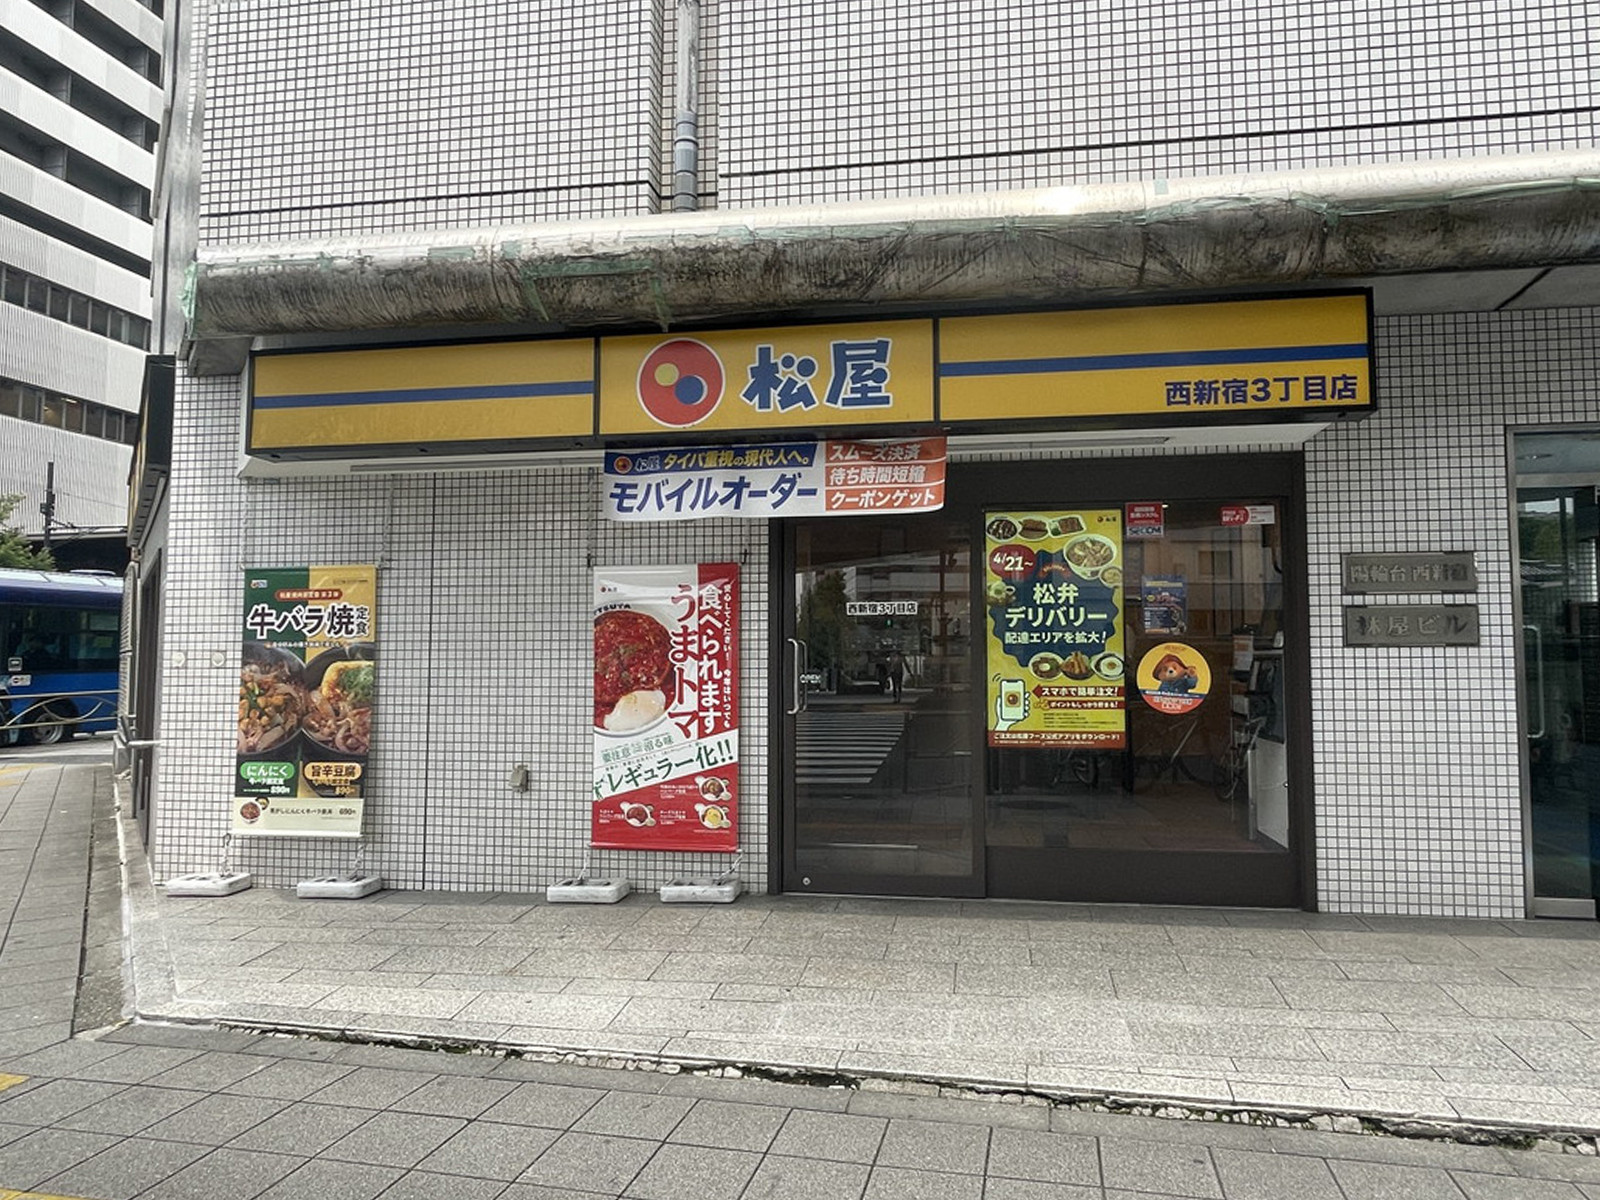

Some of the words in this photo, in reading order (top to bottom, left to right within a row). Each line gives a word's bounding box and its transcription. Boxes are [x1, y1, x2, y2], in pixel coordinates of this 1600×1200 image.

[740, 338, 893, 413] 松屋
[1164, 374, 1359, 407] 西新宿3丁目店
[664, 448, 810, 470] タイパ重視の現代人へ。
[829, 444, 922, 461] スムーズ決済
[830, 465, 926, 485] 待ち時間短縮
[609, 472, 819, 514] モバイルオーダー
[831, 488, 936, 509] クーポンゲット
[1033, 582, 1080, 605] 松弁
[848, 602, 917, 614] 西新宿3丁目店
[1005, 606, 1108, 628] デリバリー
[246, 603, 355, 639] 牛バラ焼
[1004, 631, 1106, 644] 配達エリアを拡大!
[667, 583, 699, 739] うまトマ
[699, 583, 723, 734] 食べられます
[246, 765, 288, 777] にんにく
